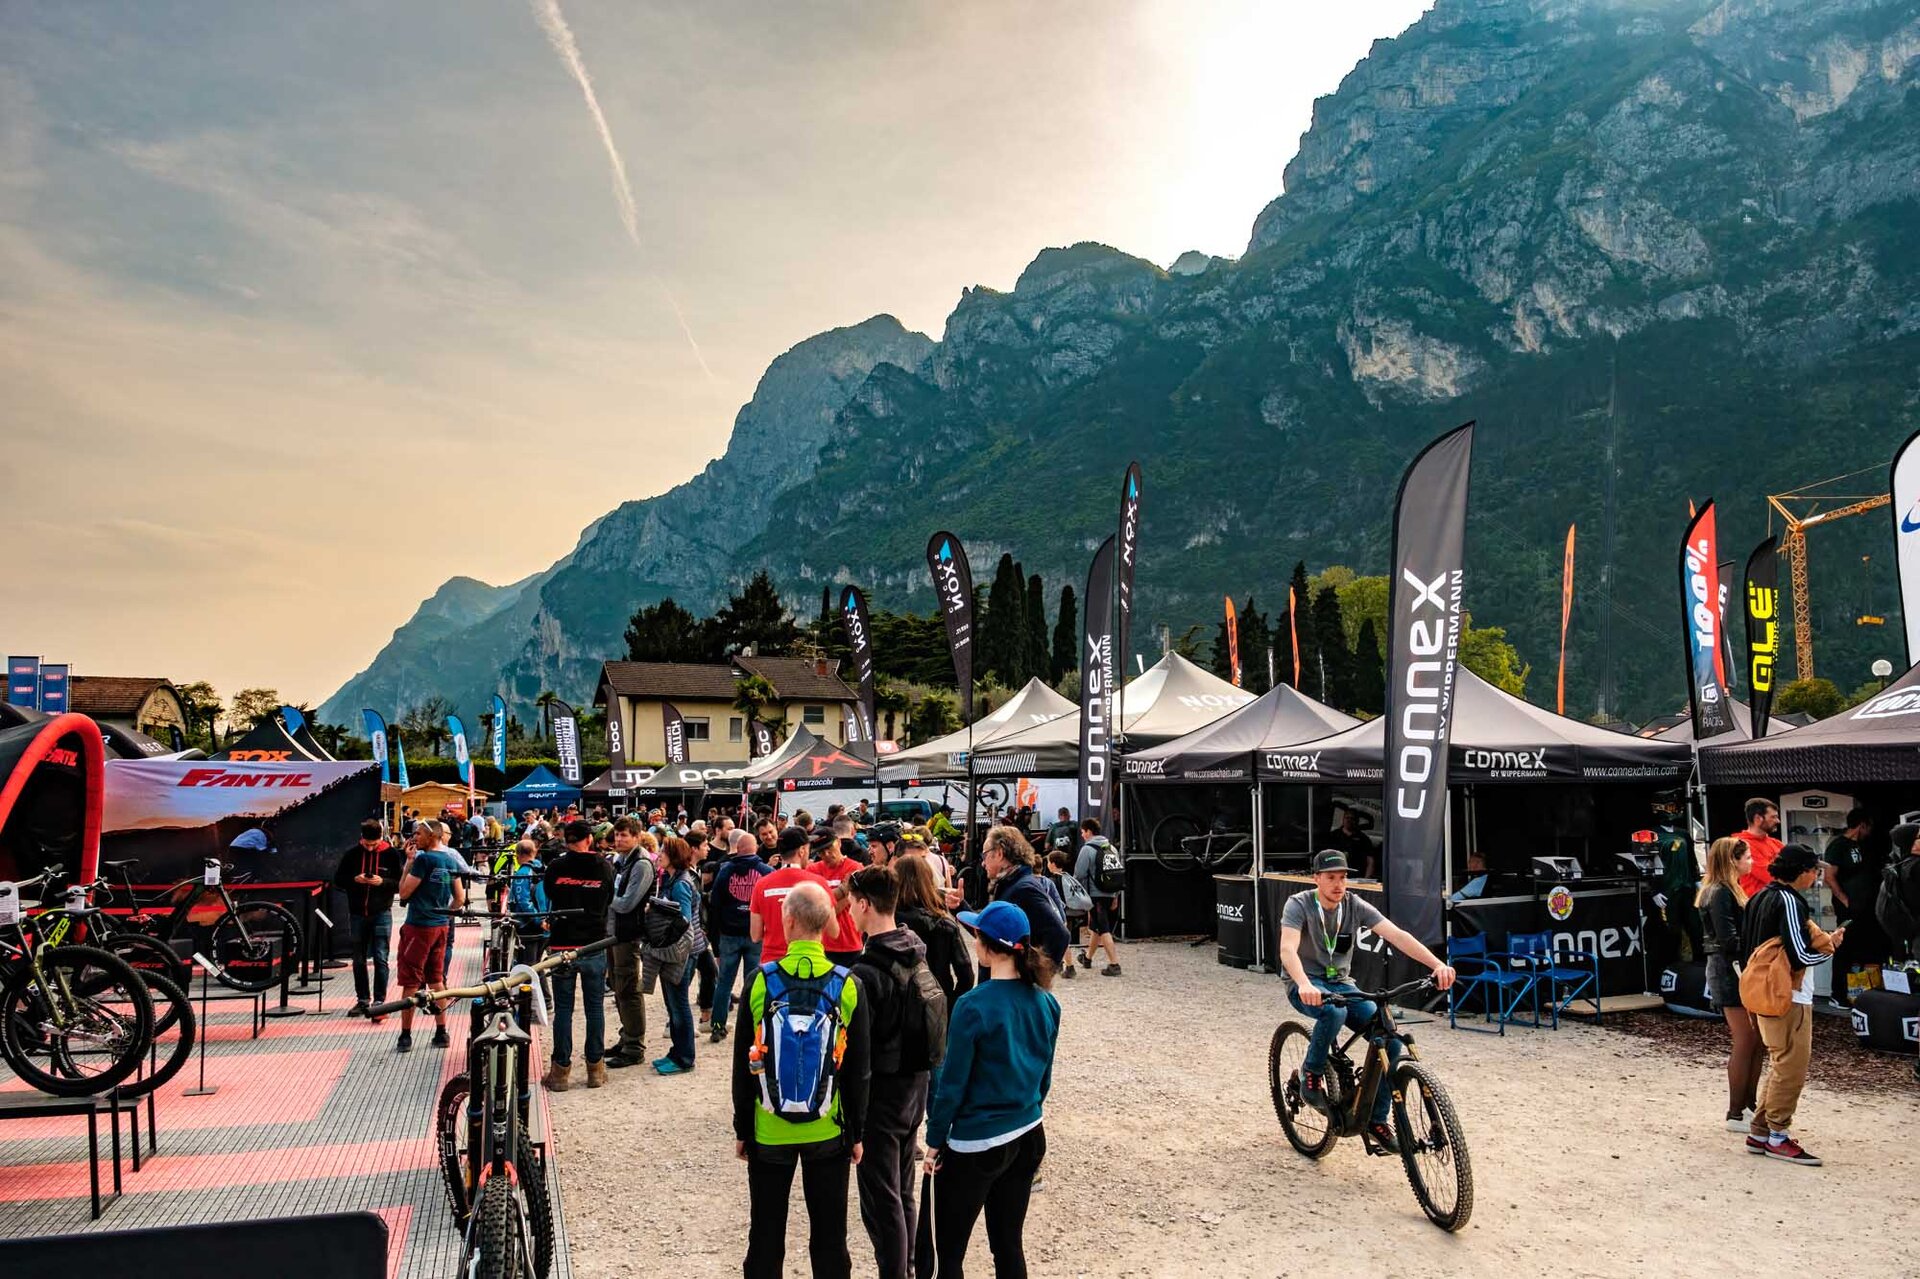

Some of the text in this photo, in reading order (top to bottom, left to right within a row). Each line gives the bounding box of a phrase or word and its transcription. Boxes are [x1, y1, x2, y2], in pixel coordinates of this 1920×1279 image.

[1688, 539, 1715, 652] 100%
[1397, 567, 1448, 819] connex
[228, 750, 292, 762] FOX
[1266, 751, 1322, 771] connex
[1465, 748, 1547, 769] connex
[1126, 758, 1168, 774] connex
[1491, 769, 1547, 778] BY WIPPERMANN
[1583, 765, 1678, 777] www.connexchain.com
[177, 769, 312, 787] FANTIC
[797, 778, 833, 788] marzocchi
[555, 876, 603, 888] FANTIC
